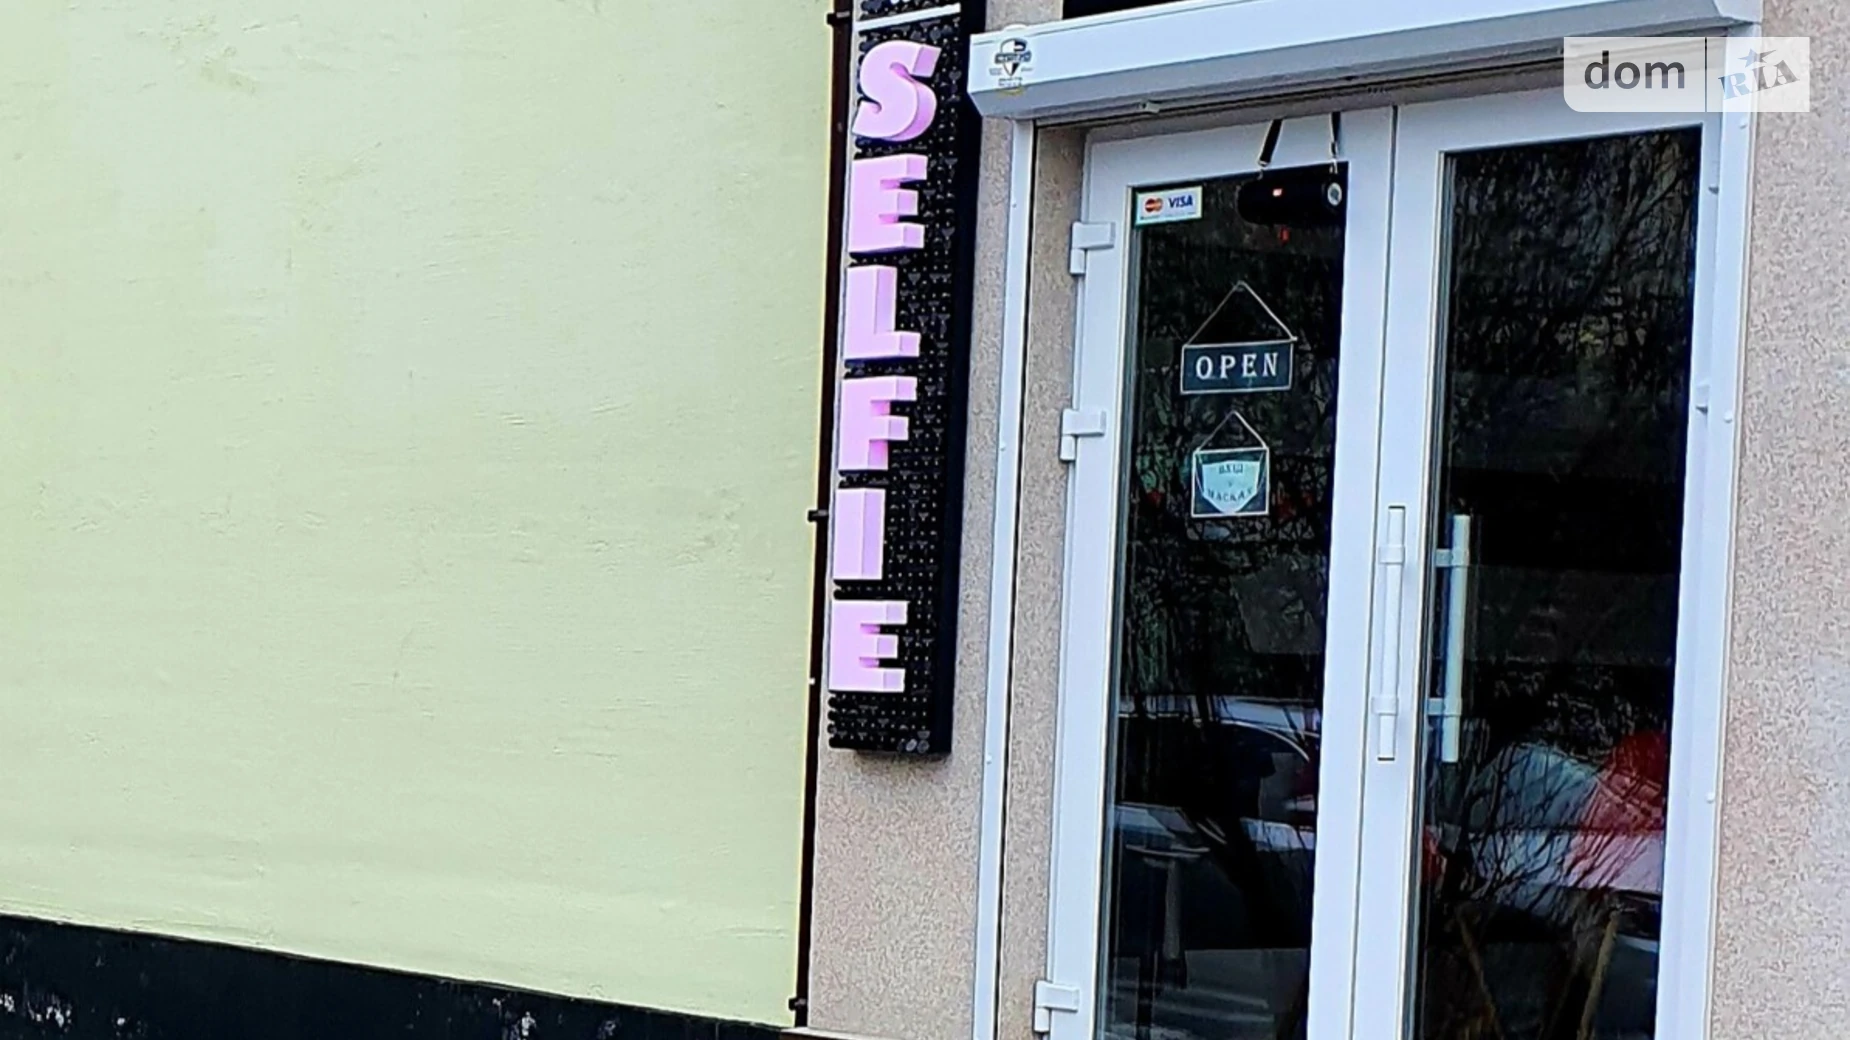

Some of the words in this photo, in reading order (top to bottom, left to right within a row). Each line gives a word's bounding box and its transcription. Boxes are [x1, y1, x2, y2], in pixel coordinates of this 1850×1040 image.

[1168, 194, 1193, 208] VISA
[828, 39, 942, 693] SELFIE
[1195, 351, 1279, 381] OPEN
